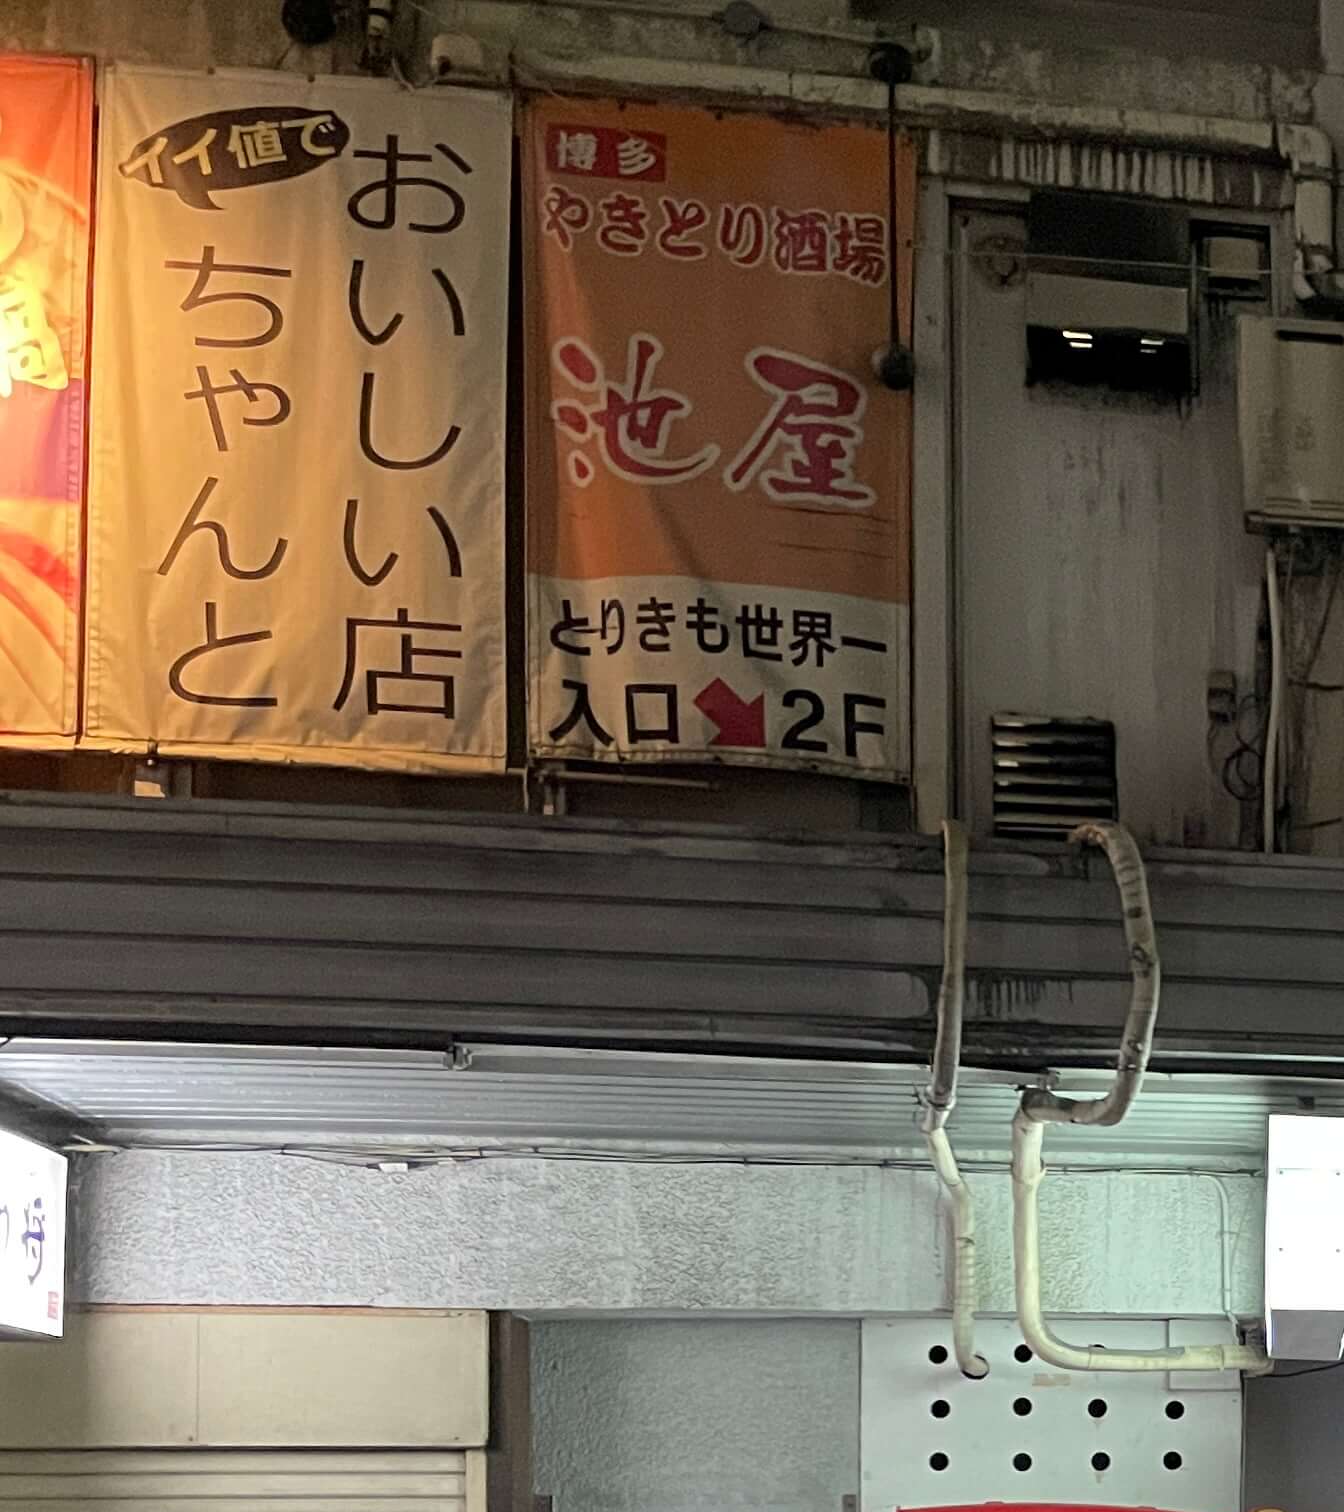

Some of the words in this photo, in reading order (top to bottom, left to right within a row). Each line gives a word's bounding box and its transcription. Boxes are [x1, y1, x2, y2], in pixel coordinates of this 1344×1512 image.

[122, 114, 336, 184] イイ値で
[557, 131, 656, 176] 博多
[544, 184, 888, 286] やきとり酒場
[334, 132, 472, 719] おいしい店
[551, 334, 877, 508] 池屋
[157, 246, 292, 707] ちゃんと
[549, 599, 888, 668] とりきも世界一
[549, 679, 679, 745] 入口
[780, 692, 887, 757] 2F
